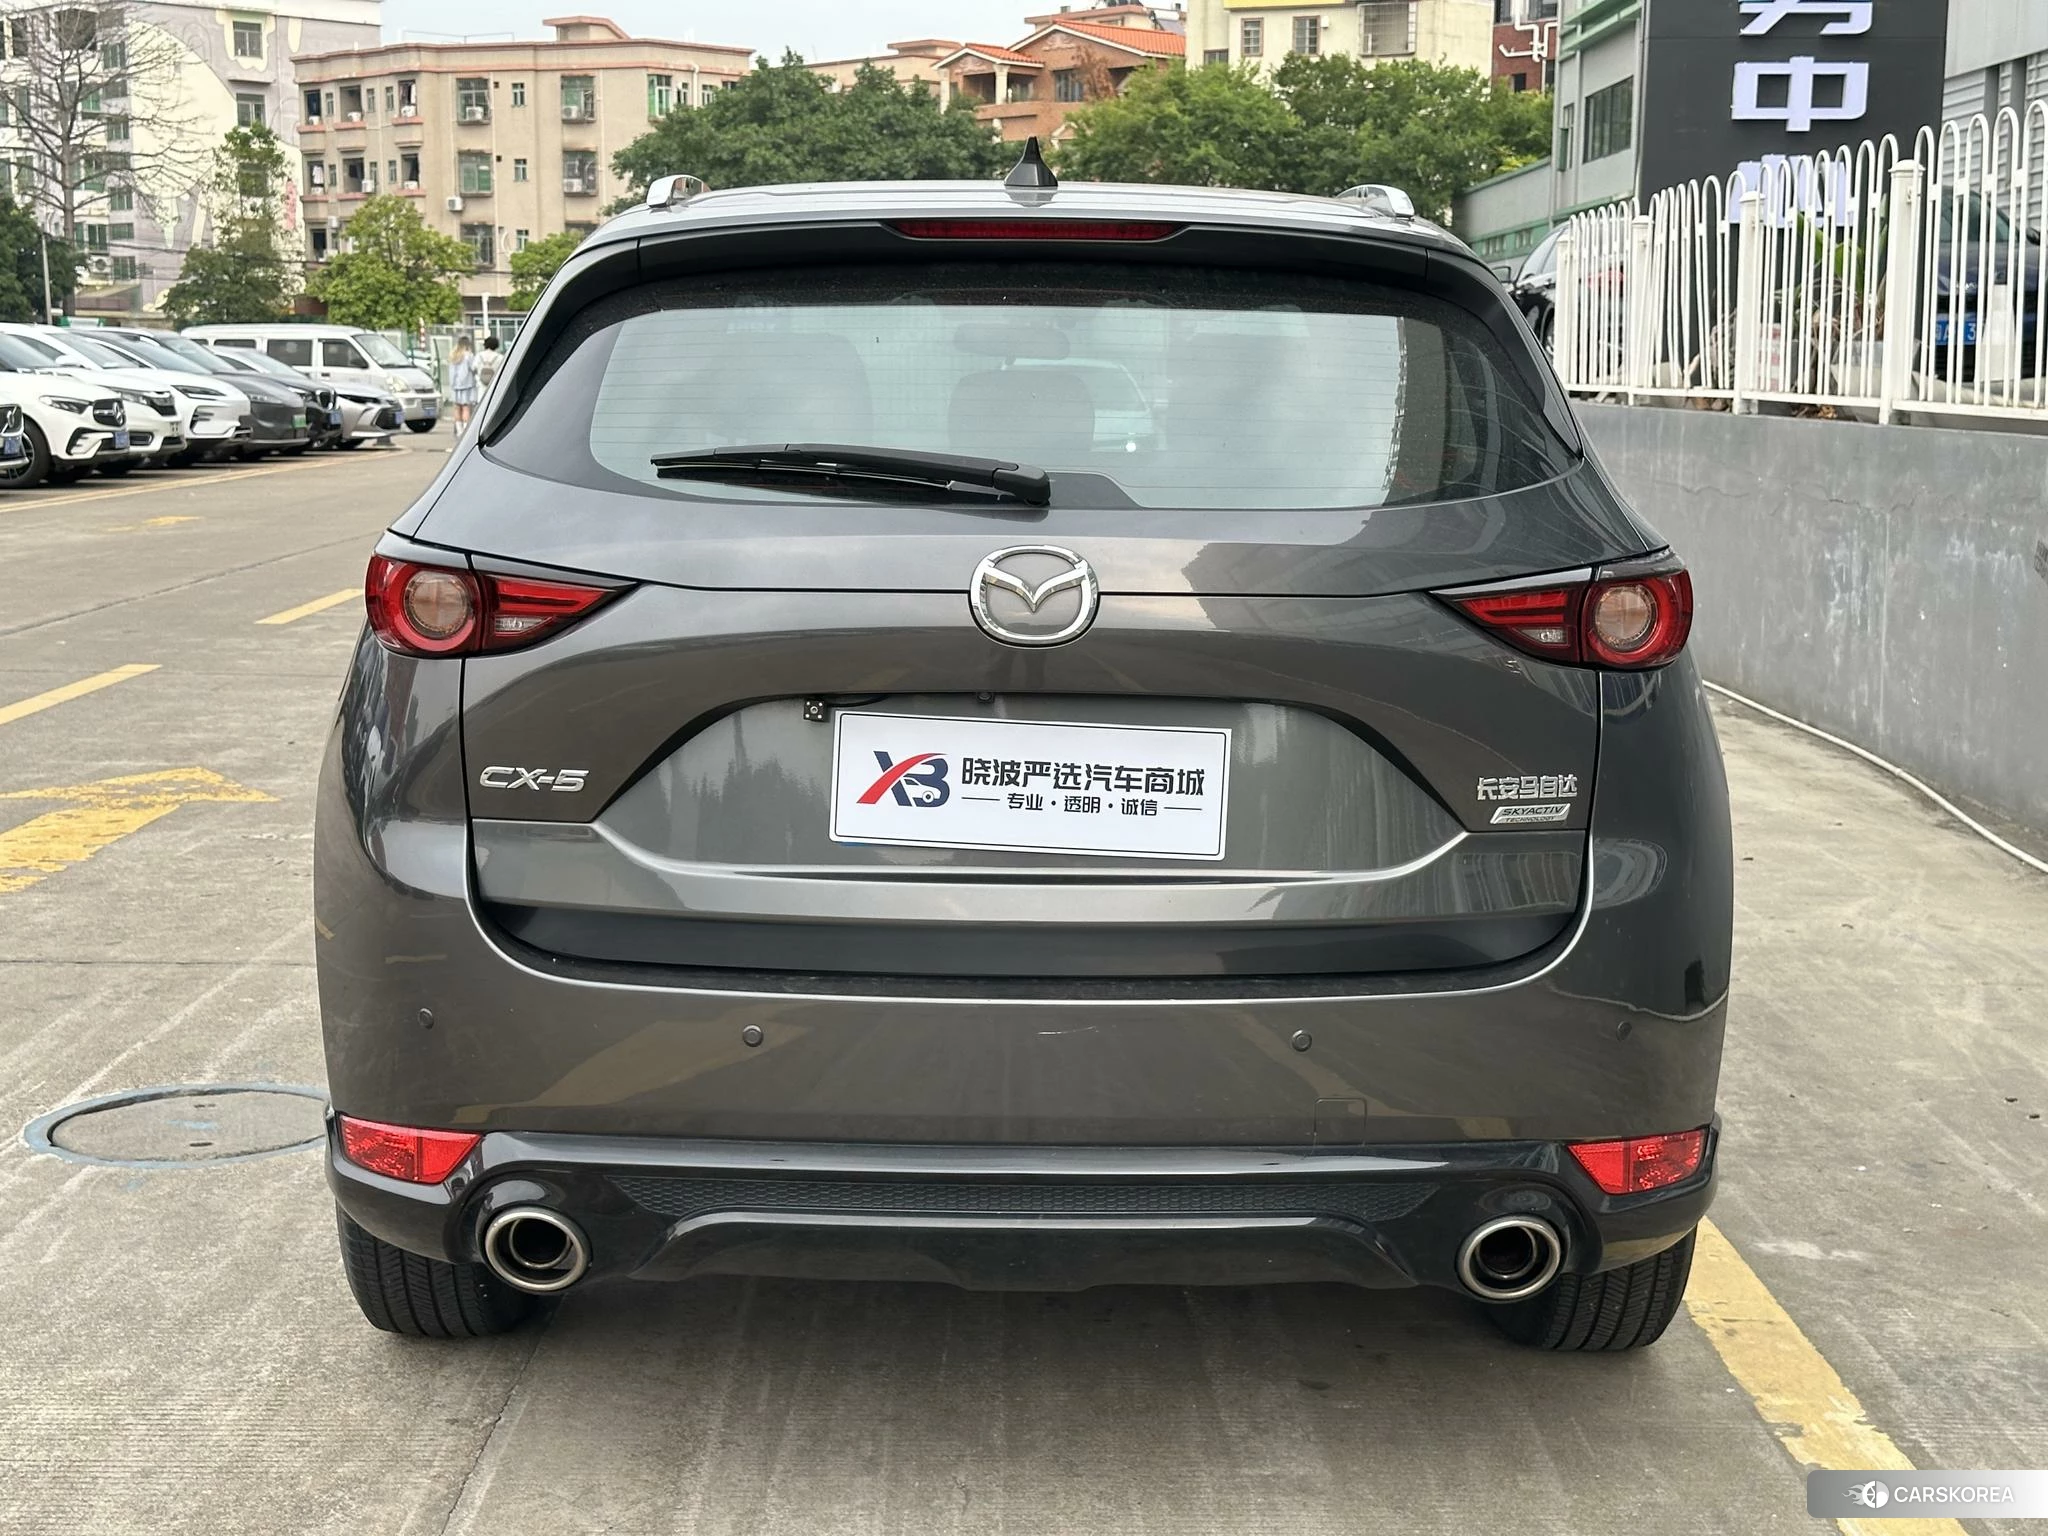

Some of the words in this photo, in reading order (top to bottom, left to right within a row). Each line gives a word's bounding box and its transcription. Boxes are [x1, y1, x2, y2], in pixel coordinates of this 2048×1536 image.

[480, 766, 589, 792] CX-5
[961, 757, 1205, 796] 晓波严选汽车商城
[1477, 774, 1578, 800] 长安马自达
[1501, 806, 1564, 816] SKYACTIV
